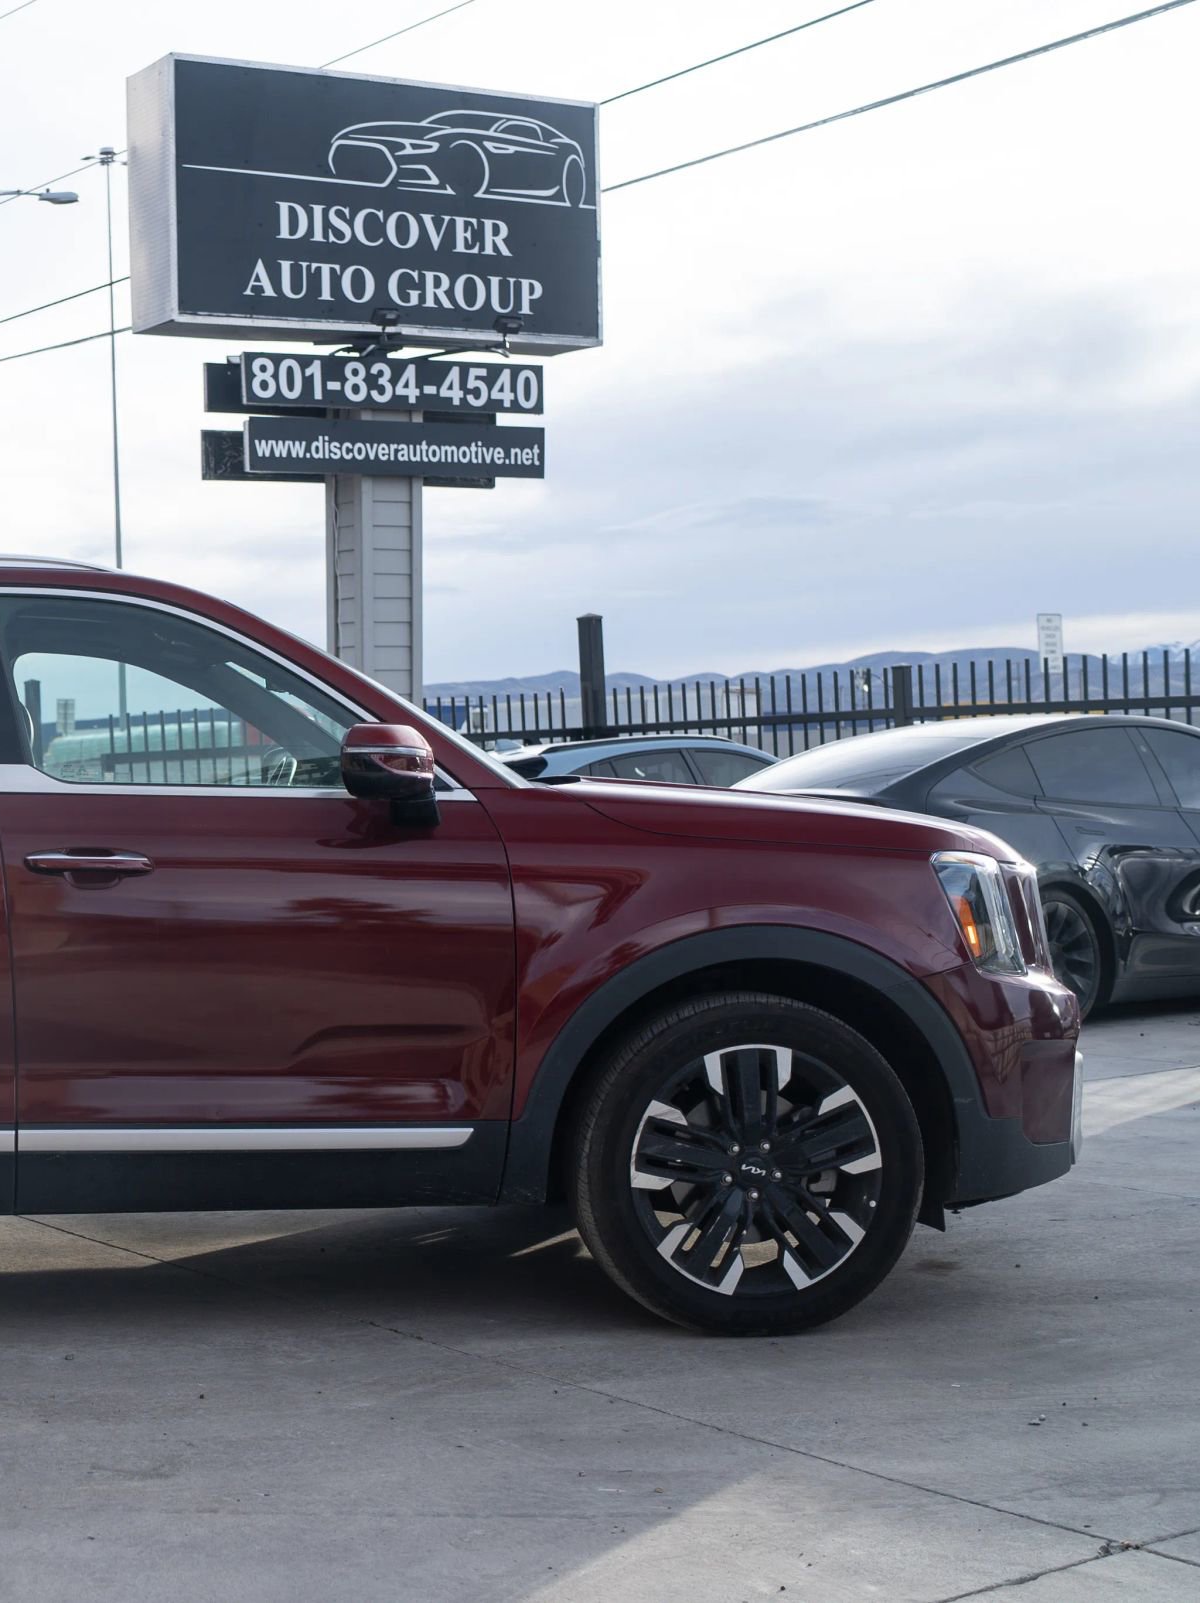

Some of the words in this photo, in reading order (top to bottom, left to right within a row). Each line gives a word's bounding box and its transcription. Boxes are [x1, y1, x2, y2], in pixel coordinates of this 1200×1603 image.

[276, 200, 513, 256] DISCOVER
[243, 258, 376, 303] AUTO
[387, 268, 544, 315] GROUP
[251, 357, 539, 409] 801-834-4540
[254, 435, 541, 466] www.discoverautomotive.net
